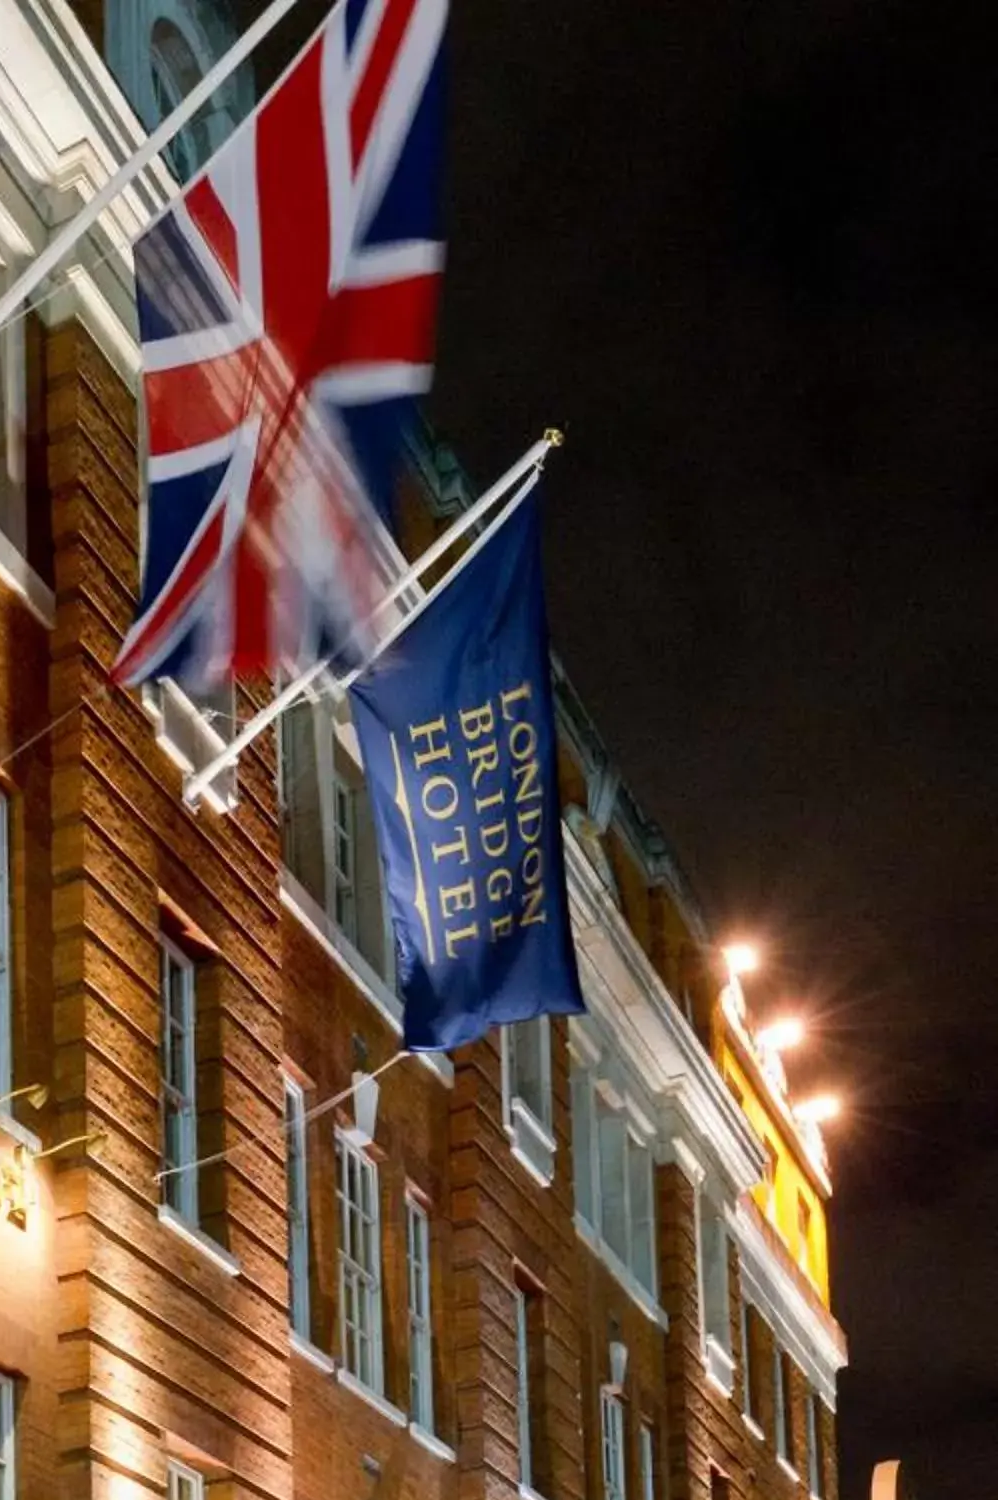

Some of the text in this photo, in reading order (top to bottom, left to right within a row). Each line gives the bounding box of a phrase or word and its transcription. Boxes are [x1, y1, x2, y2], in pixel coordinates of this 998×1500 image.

[409, 714, 479, 959] HOTEL
[458, 701, 514, 943] BRIDGE
[498, 681, 547, 928] LONDON
